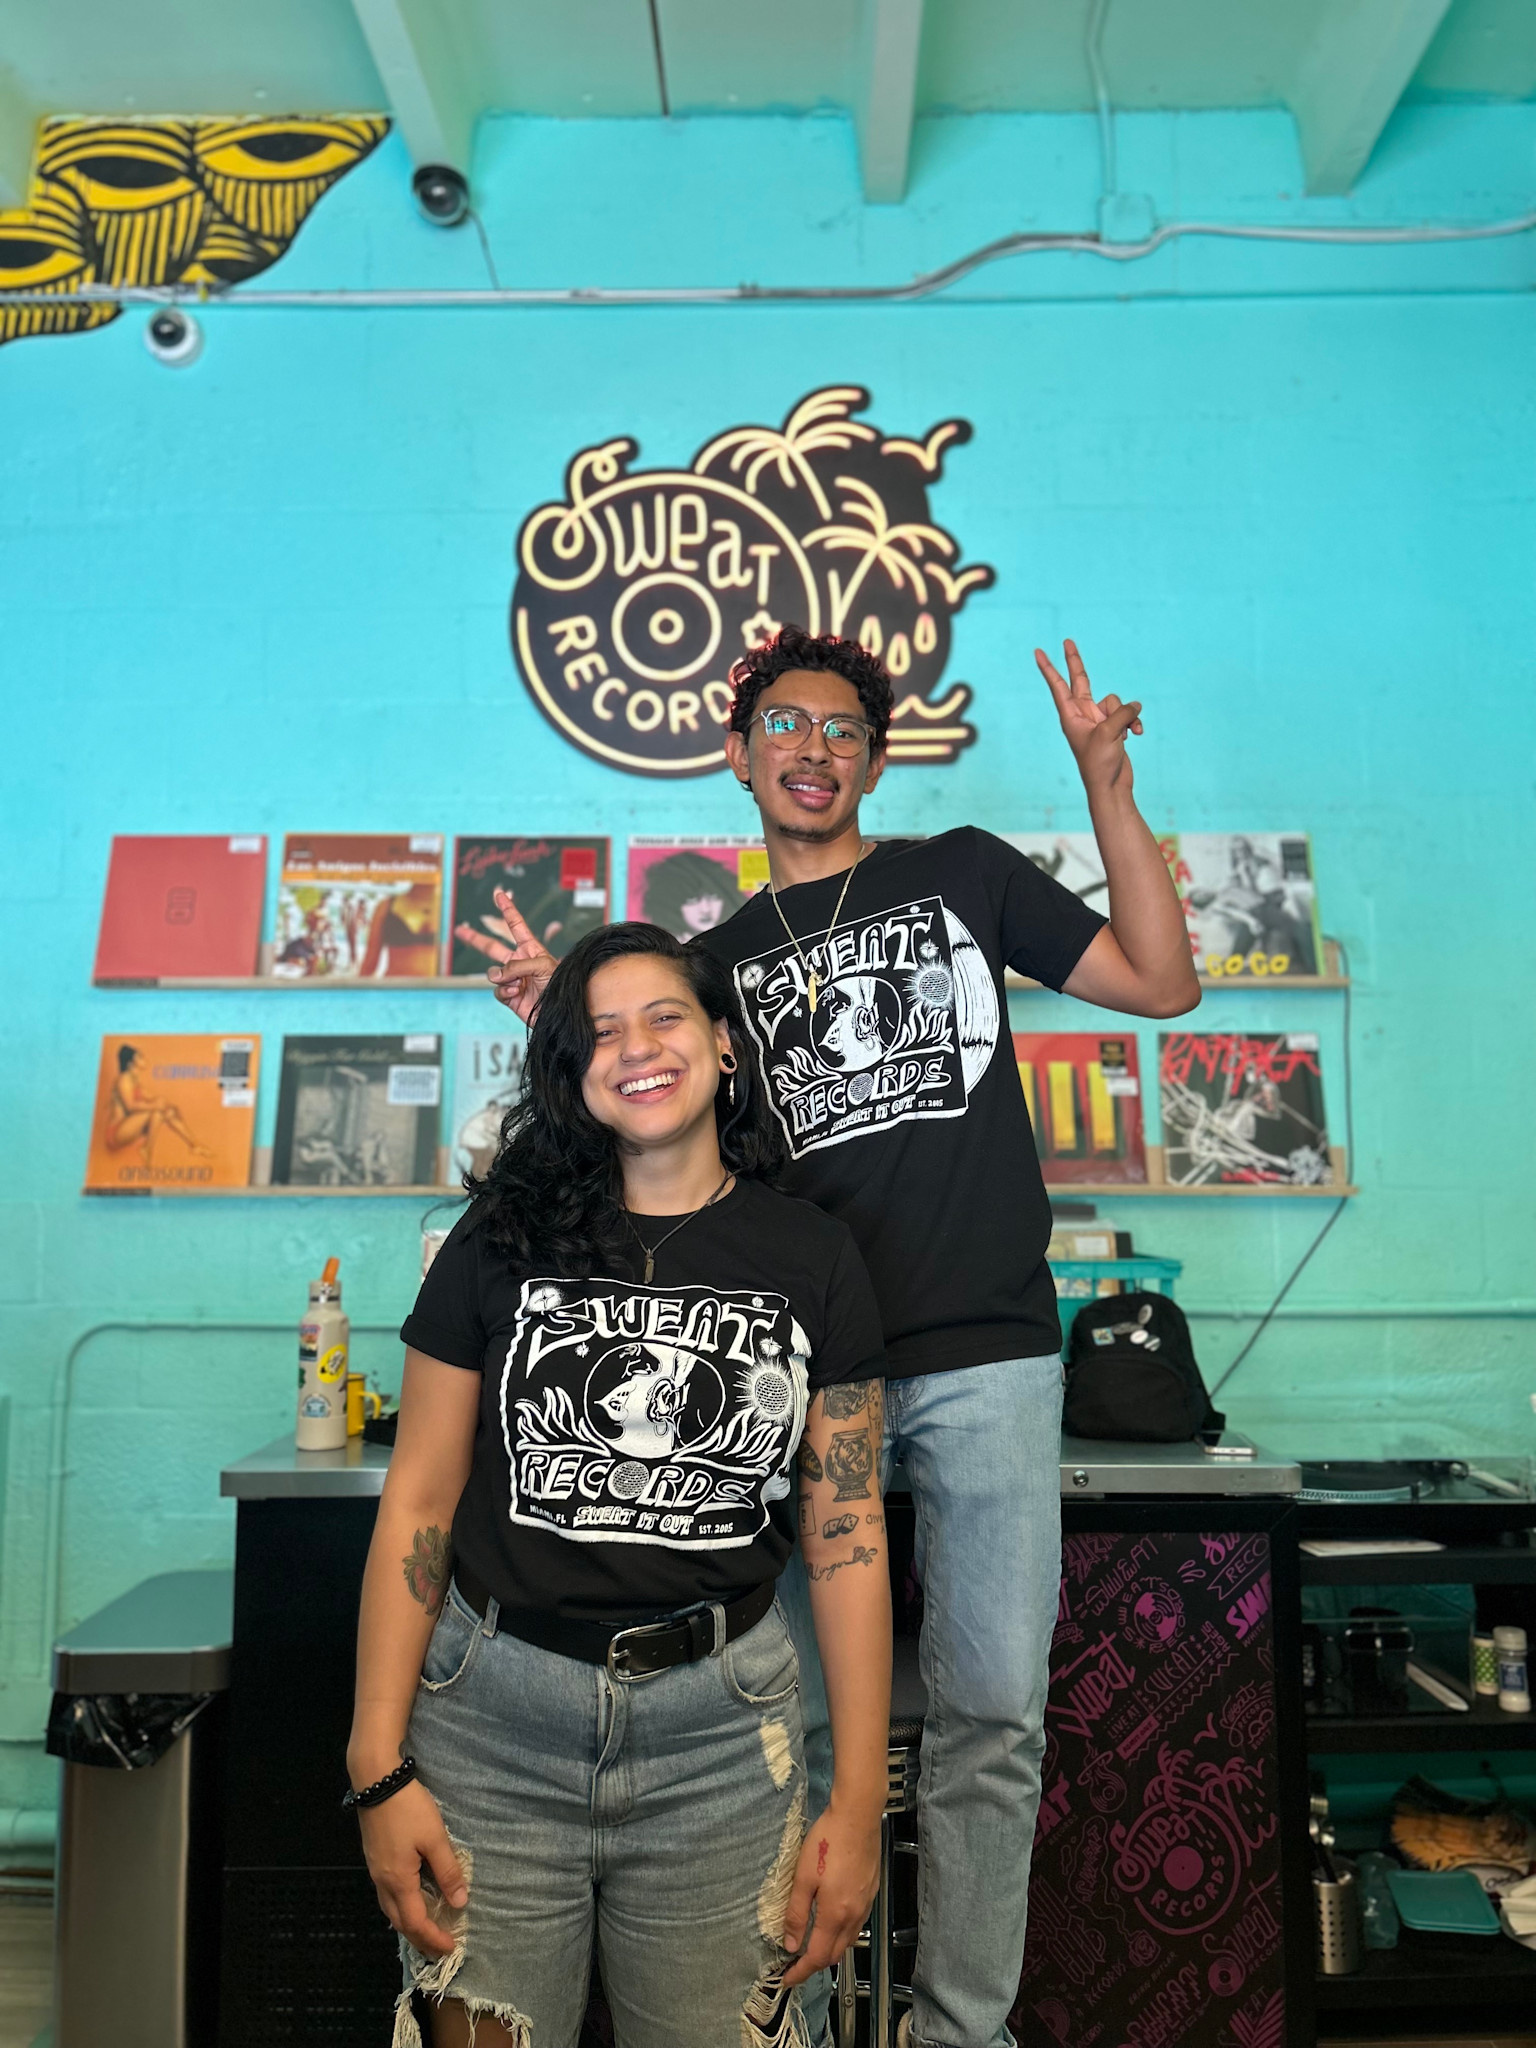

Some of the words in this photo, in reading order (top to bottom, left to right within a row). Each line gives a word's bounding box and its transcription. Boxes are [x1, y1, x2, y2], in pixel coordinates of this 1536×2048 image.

[757, 911, 934, 1050] SWEAT
[788, 1055, 952, 1137] RECORDS
[526, 1295, 780, 1379] SWEAT
[519, 1451, 757, 1516] RECORDS
[573, 1504, 637, 1529] SWEAT
[635, 1511, 660, 1530] IT
[659, 1513, 696, 1536] OUT
[698, 1524, 714, 1535] EST.
[714, 1522, 734, 1534] 2005
